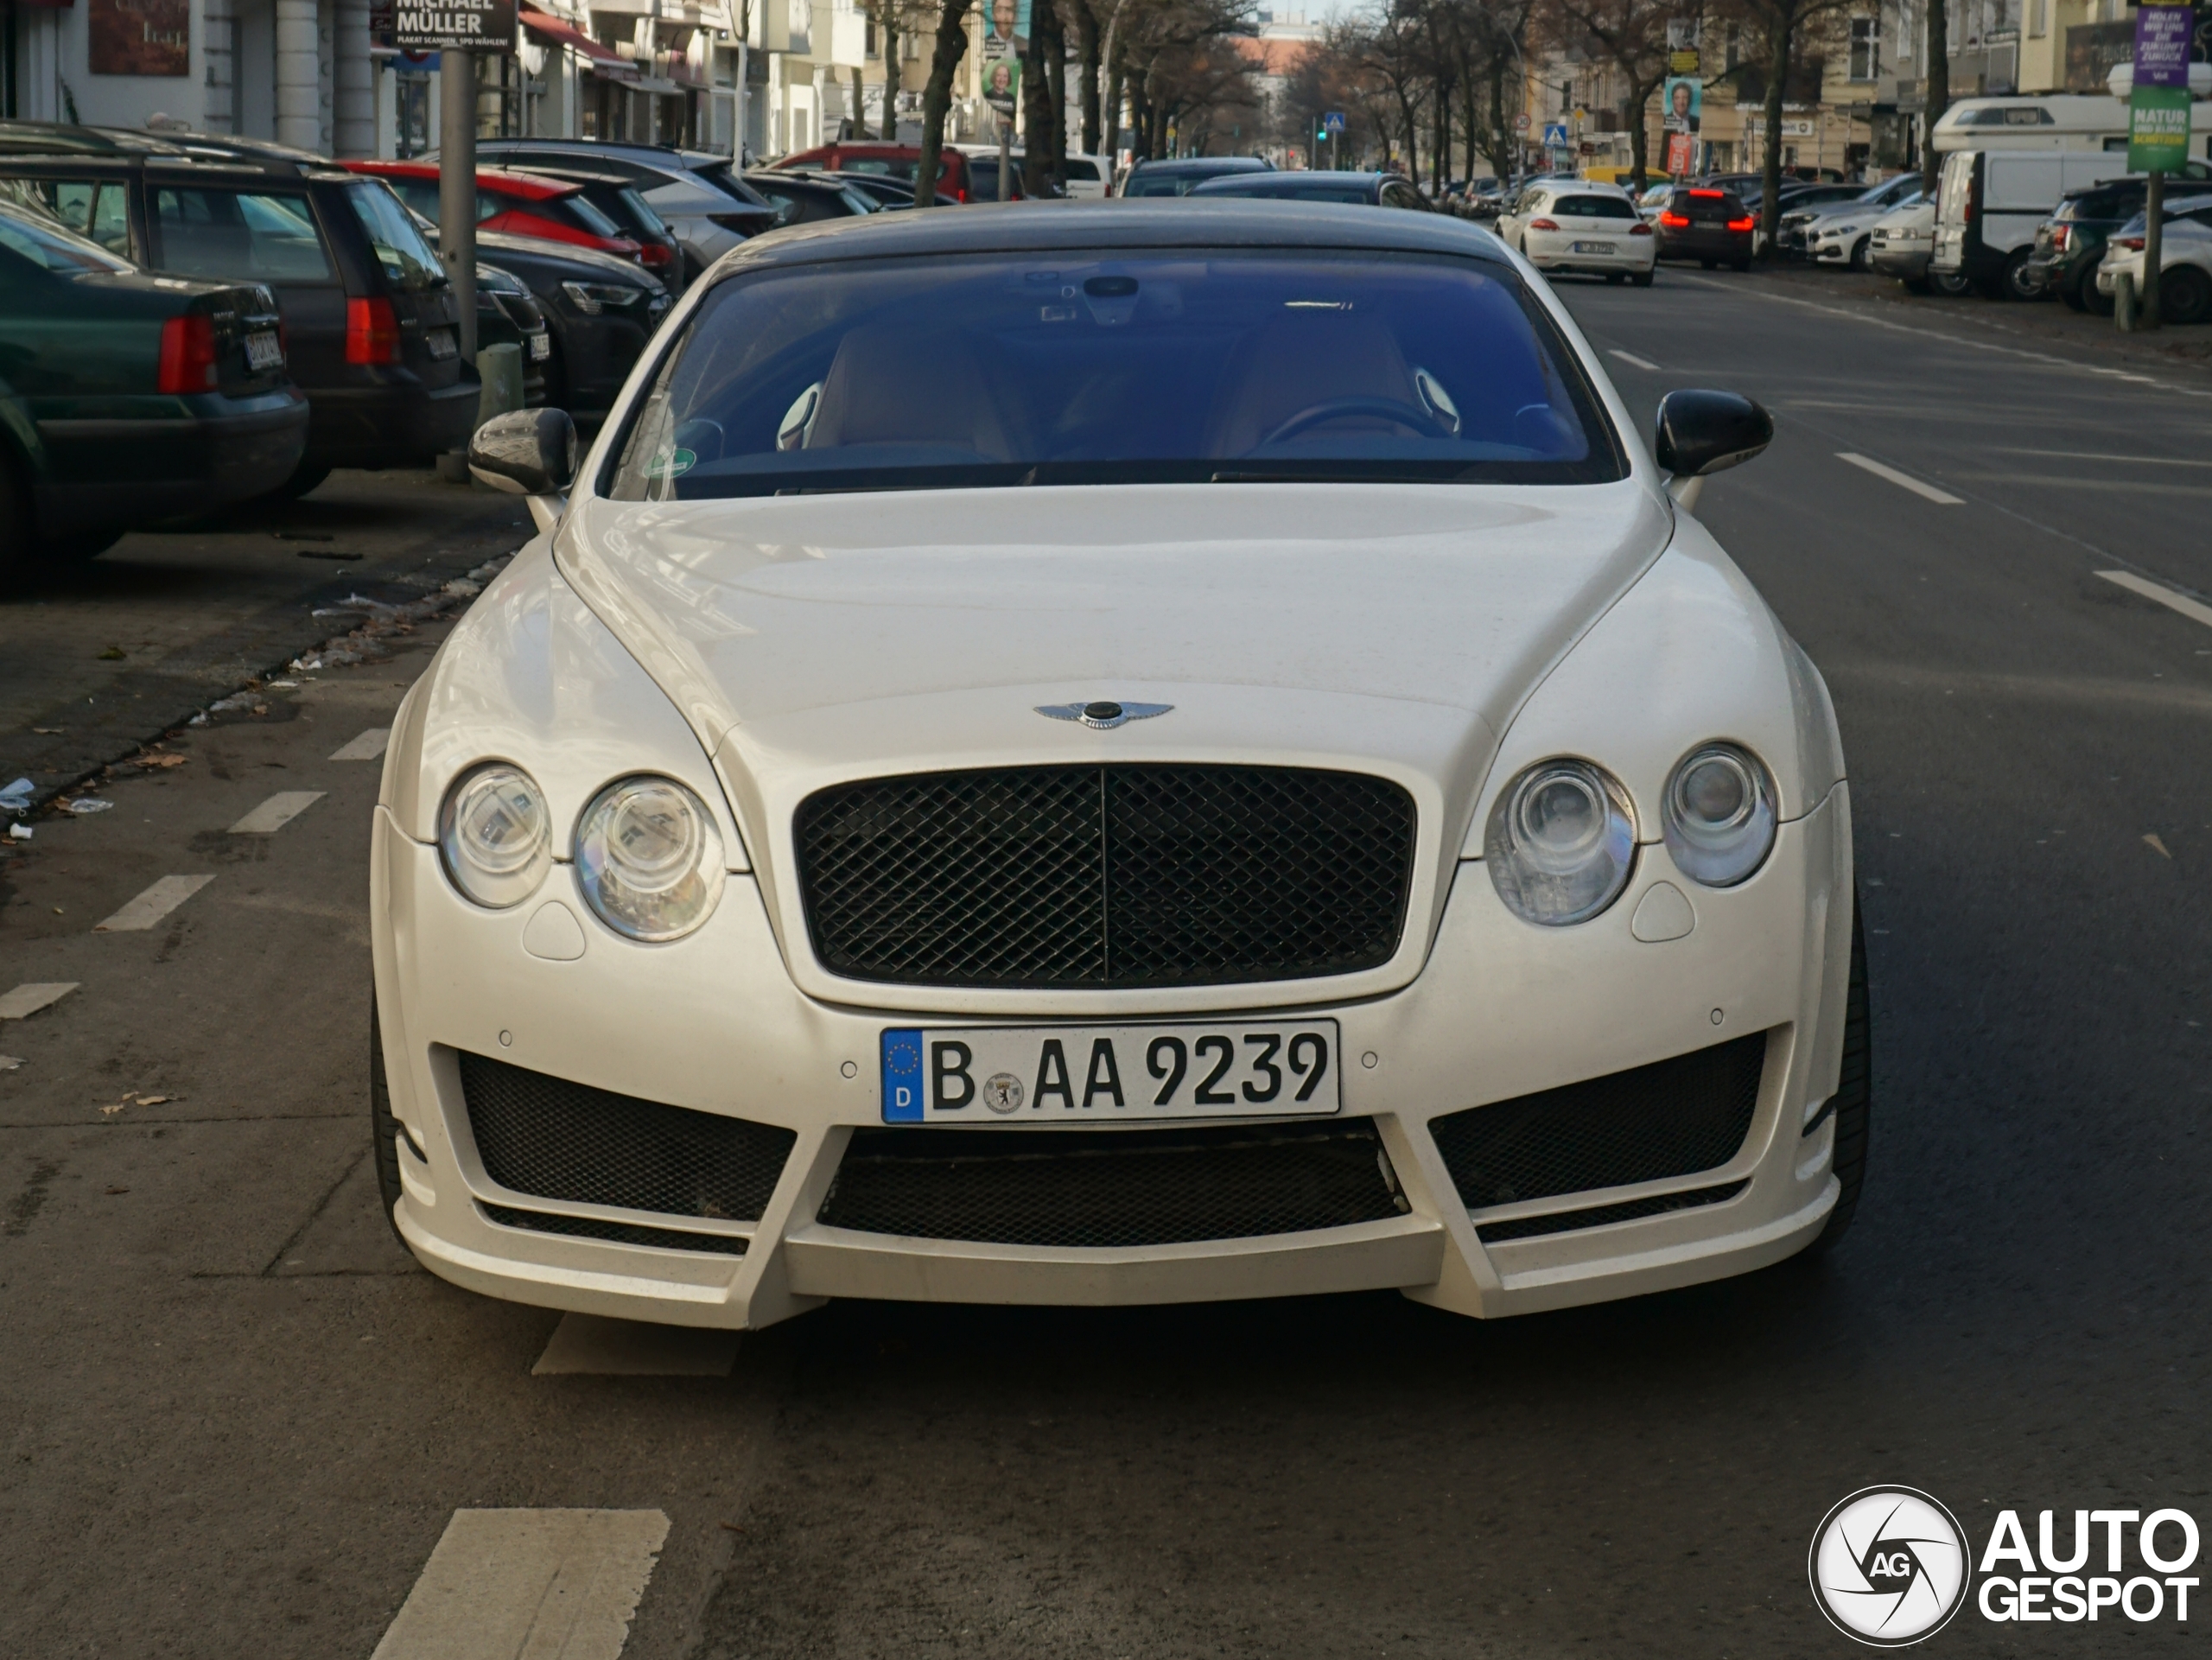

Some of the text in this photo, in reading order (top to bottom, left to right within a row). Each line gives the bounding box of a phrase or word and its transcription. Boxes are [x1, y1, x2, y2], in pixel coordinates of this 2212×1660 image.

[397, 8, 481, 33] MÜLLER
[2148, 11, 2182, 21] HOLEN
[2144, 21, 2185, 32] WIR UNS
[424, 36, 458, 45] SCANNEN,
[475, 36, 508, 47] WÄHLEN!
[2155, 32, 2171, 41] DIE
[2139, 41, 2186, 51] ZUKUNFT
[2142, 51, 2181, 61] ZURÜCK
[2134, 108, 2187, 123] NATUR
[1518, 117, 1529, 125] 30
[2133, 124, 2154, 133] UND
[931, 1033, 1328, 1110] B AA 9239
[896, 1088, 911, 1107] D
